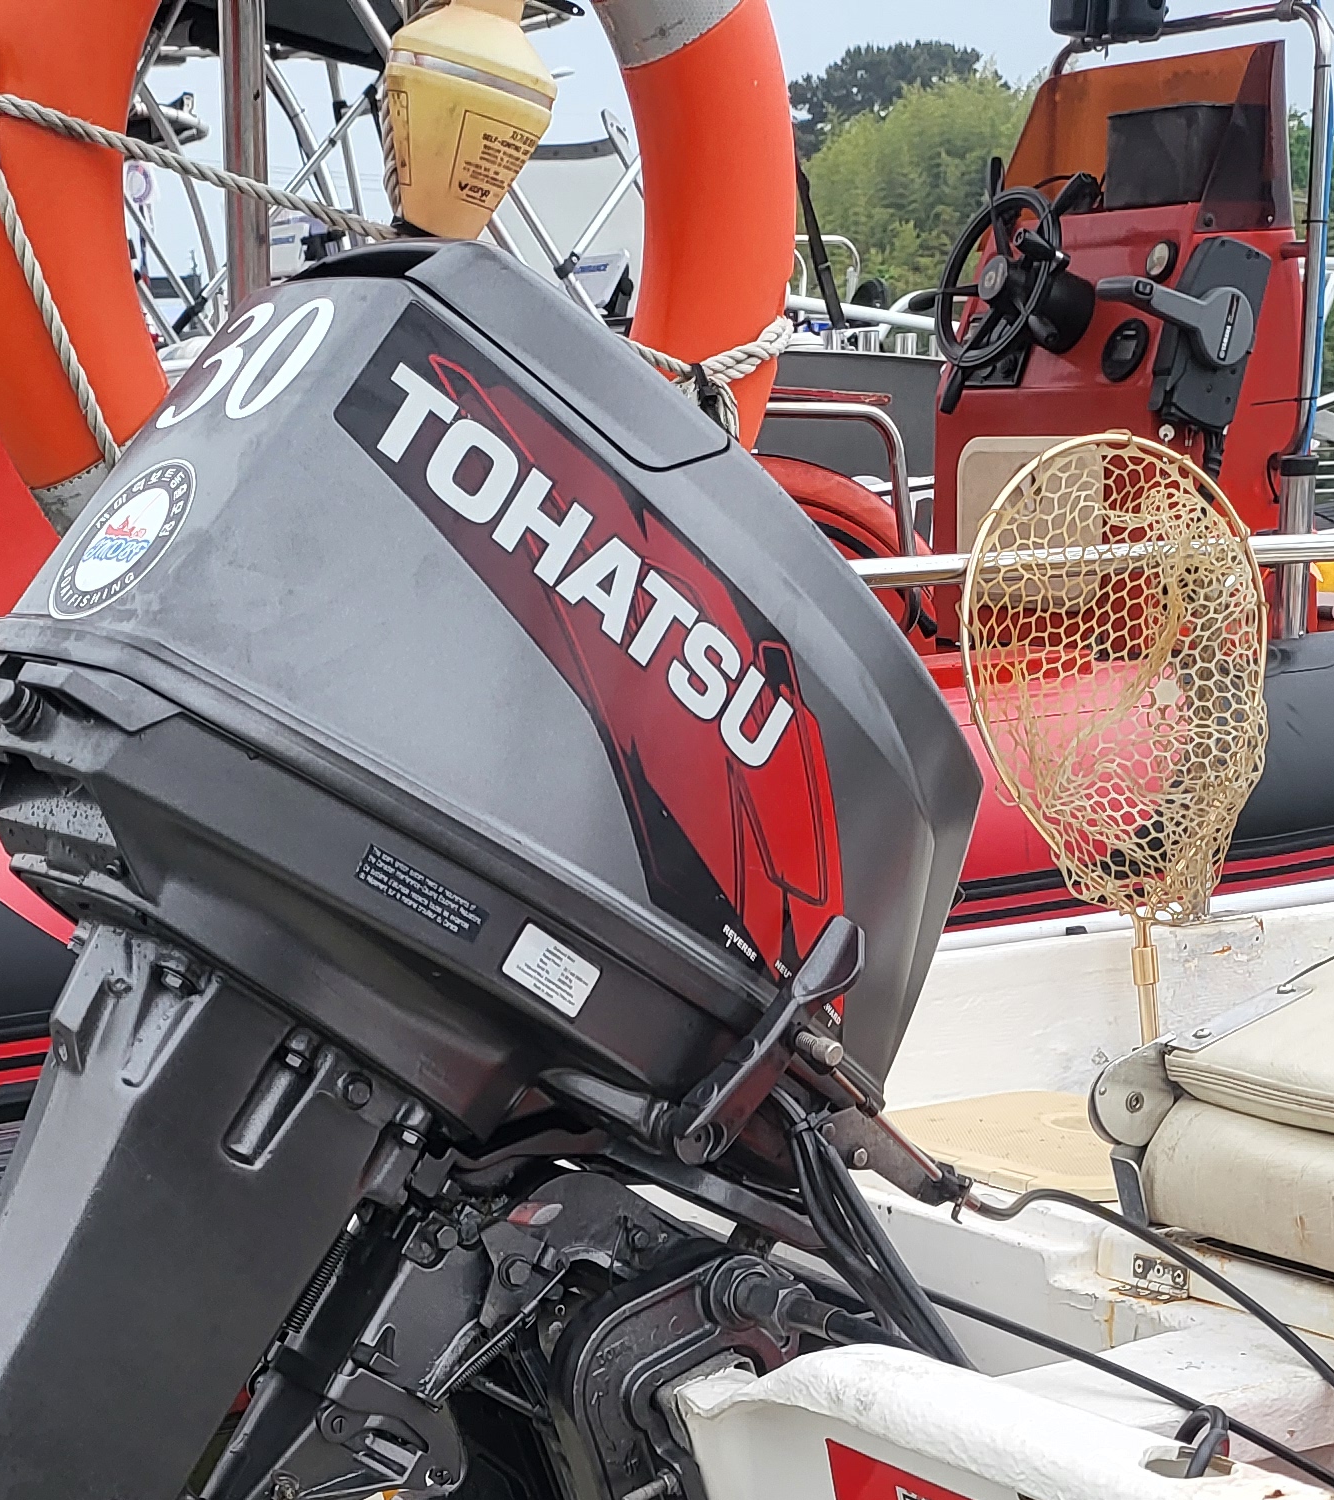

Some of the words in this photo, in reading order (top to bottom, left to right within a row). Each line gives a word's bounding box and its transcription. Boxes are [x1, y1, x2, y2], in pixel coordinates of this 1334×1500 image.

[155, 298, 335, 429] 30
[377, 363, 793, 767] TOHATSU
[721, 923, 759, 962] REVERSE
